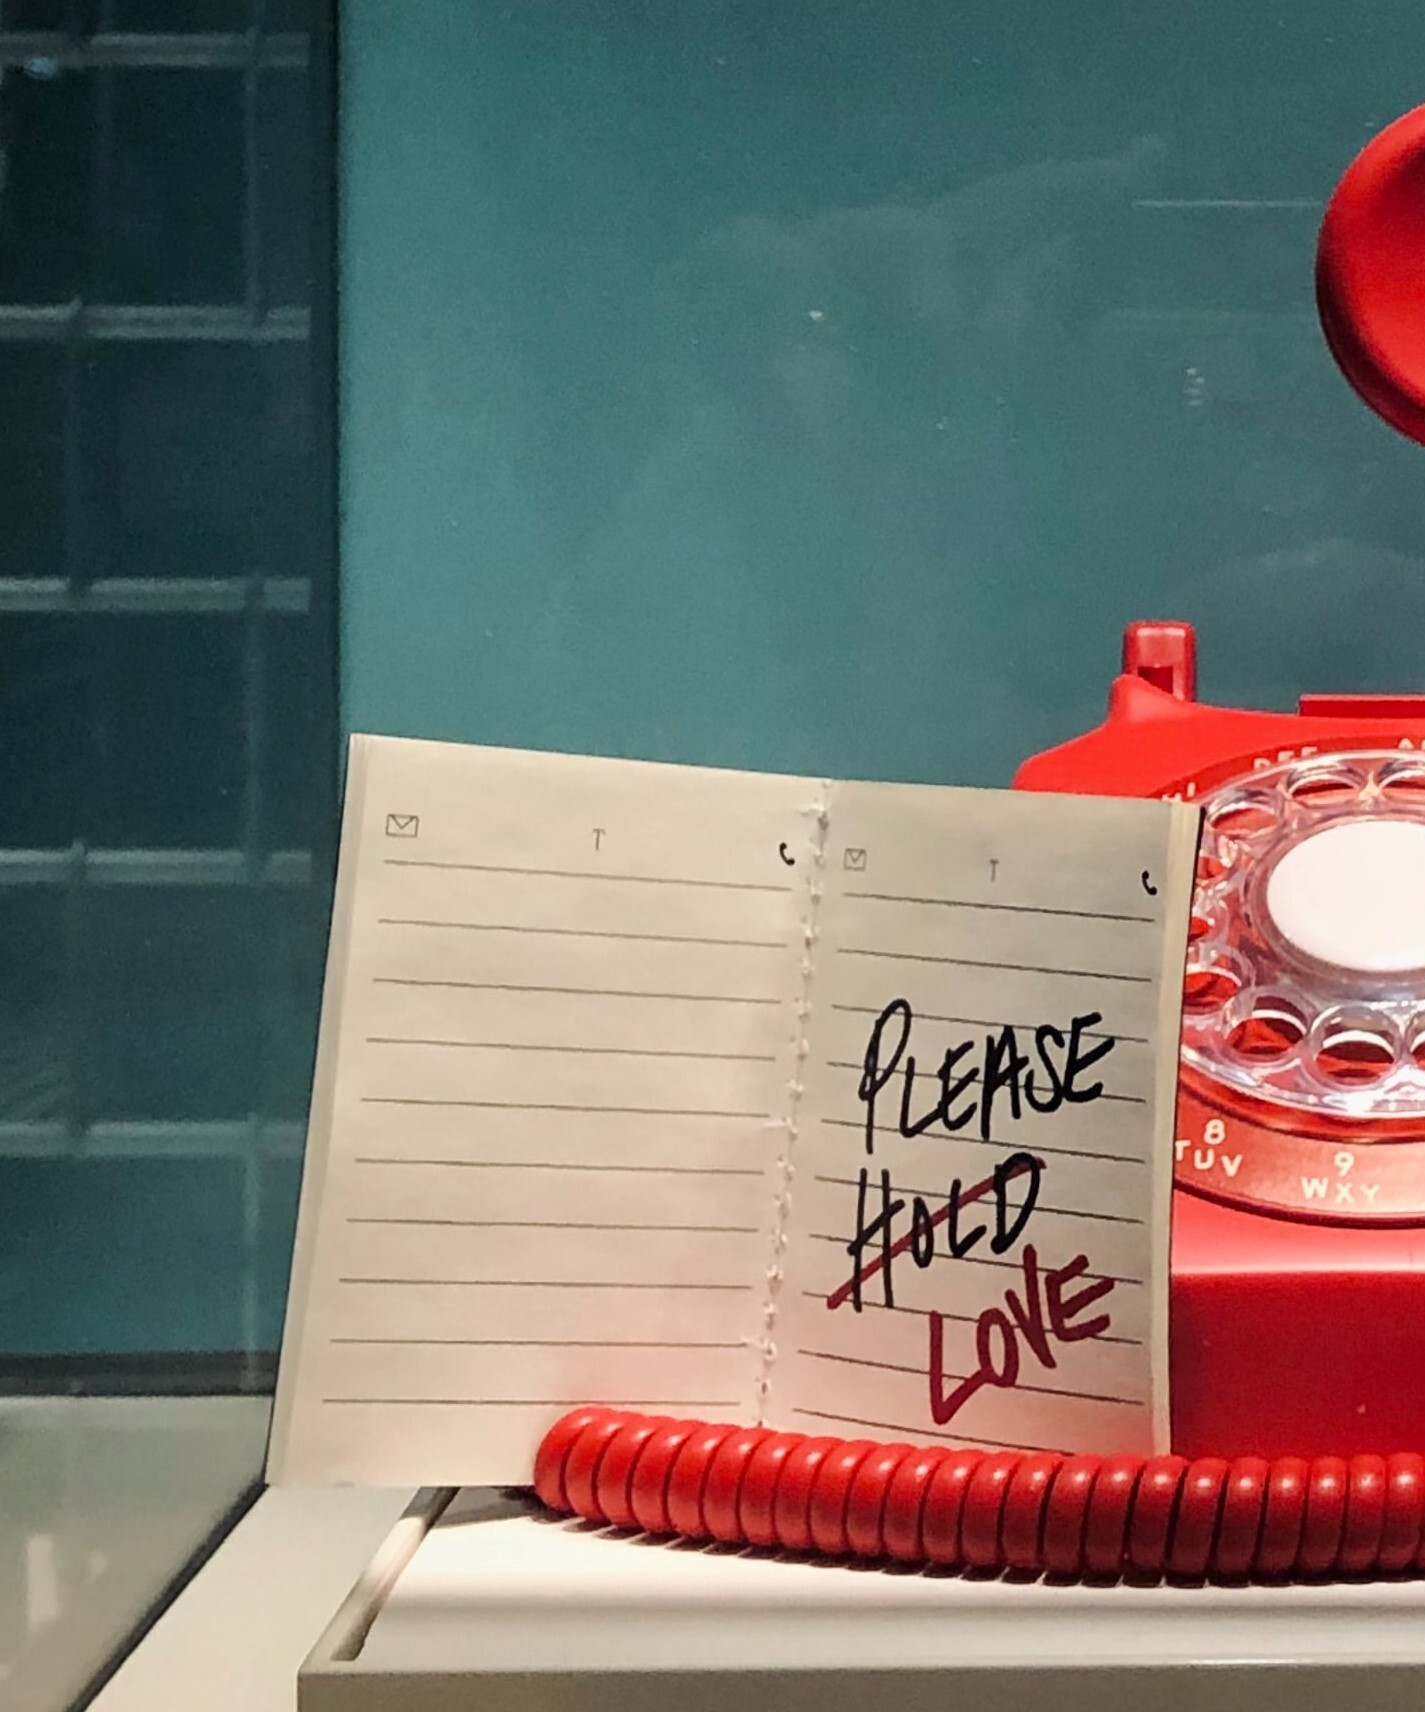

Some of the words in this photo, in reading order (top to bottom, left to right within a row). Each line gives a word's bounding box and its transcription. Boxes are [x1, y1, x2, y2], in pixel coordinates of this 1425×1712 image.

[858, 998, 1116, 1155] PLEASE
[1203, 1119, 1226, 1145] 8
[1175, 1139, 1243, 1177] TUV
[1334, 1151, 1355, 1177] 9
[1301, 1177, 1381, 1205] WXY
[846, 1151, 1042, 1313] HOLD
[928, 1243, 1116, 1426] LOVE
